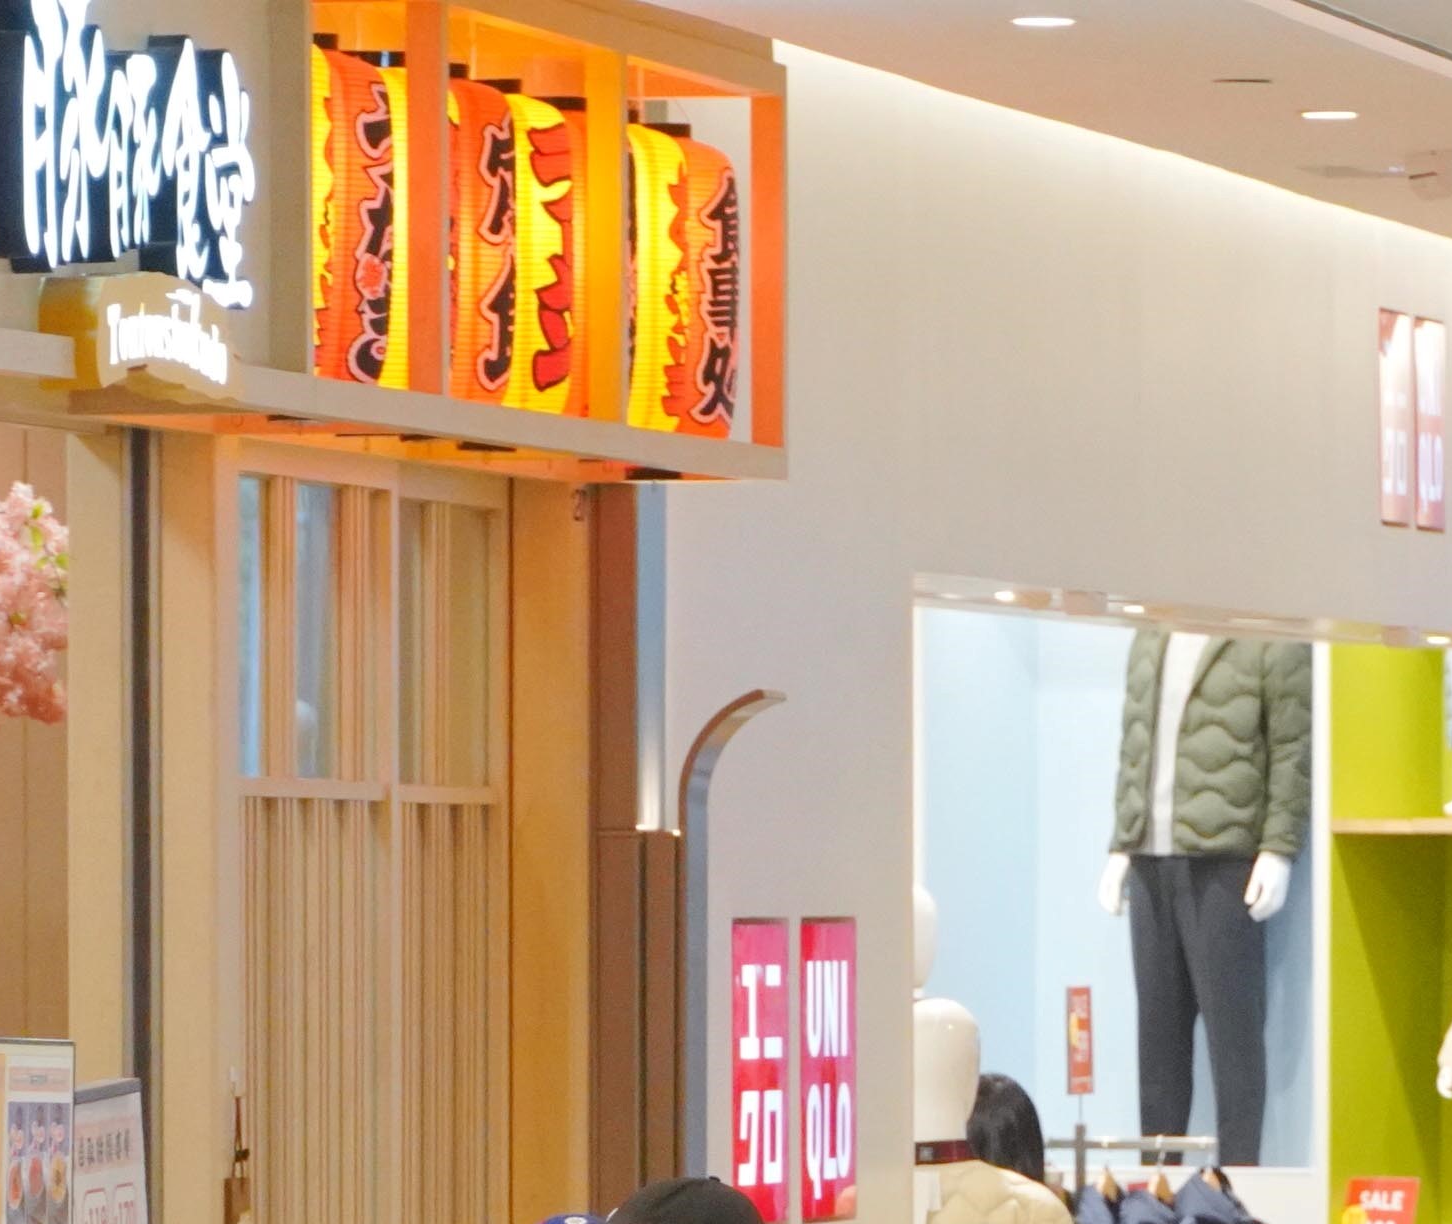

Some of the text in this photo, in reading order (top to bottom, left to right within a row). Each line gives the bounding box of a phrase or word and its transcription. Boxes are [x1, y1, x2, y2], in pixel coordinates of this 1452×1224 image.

[805, 960, 849, 1059] UNI
[805, 1081, 852, 1201] QLO
[1359, 1189, 1406, 1212] SALE
